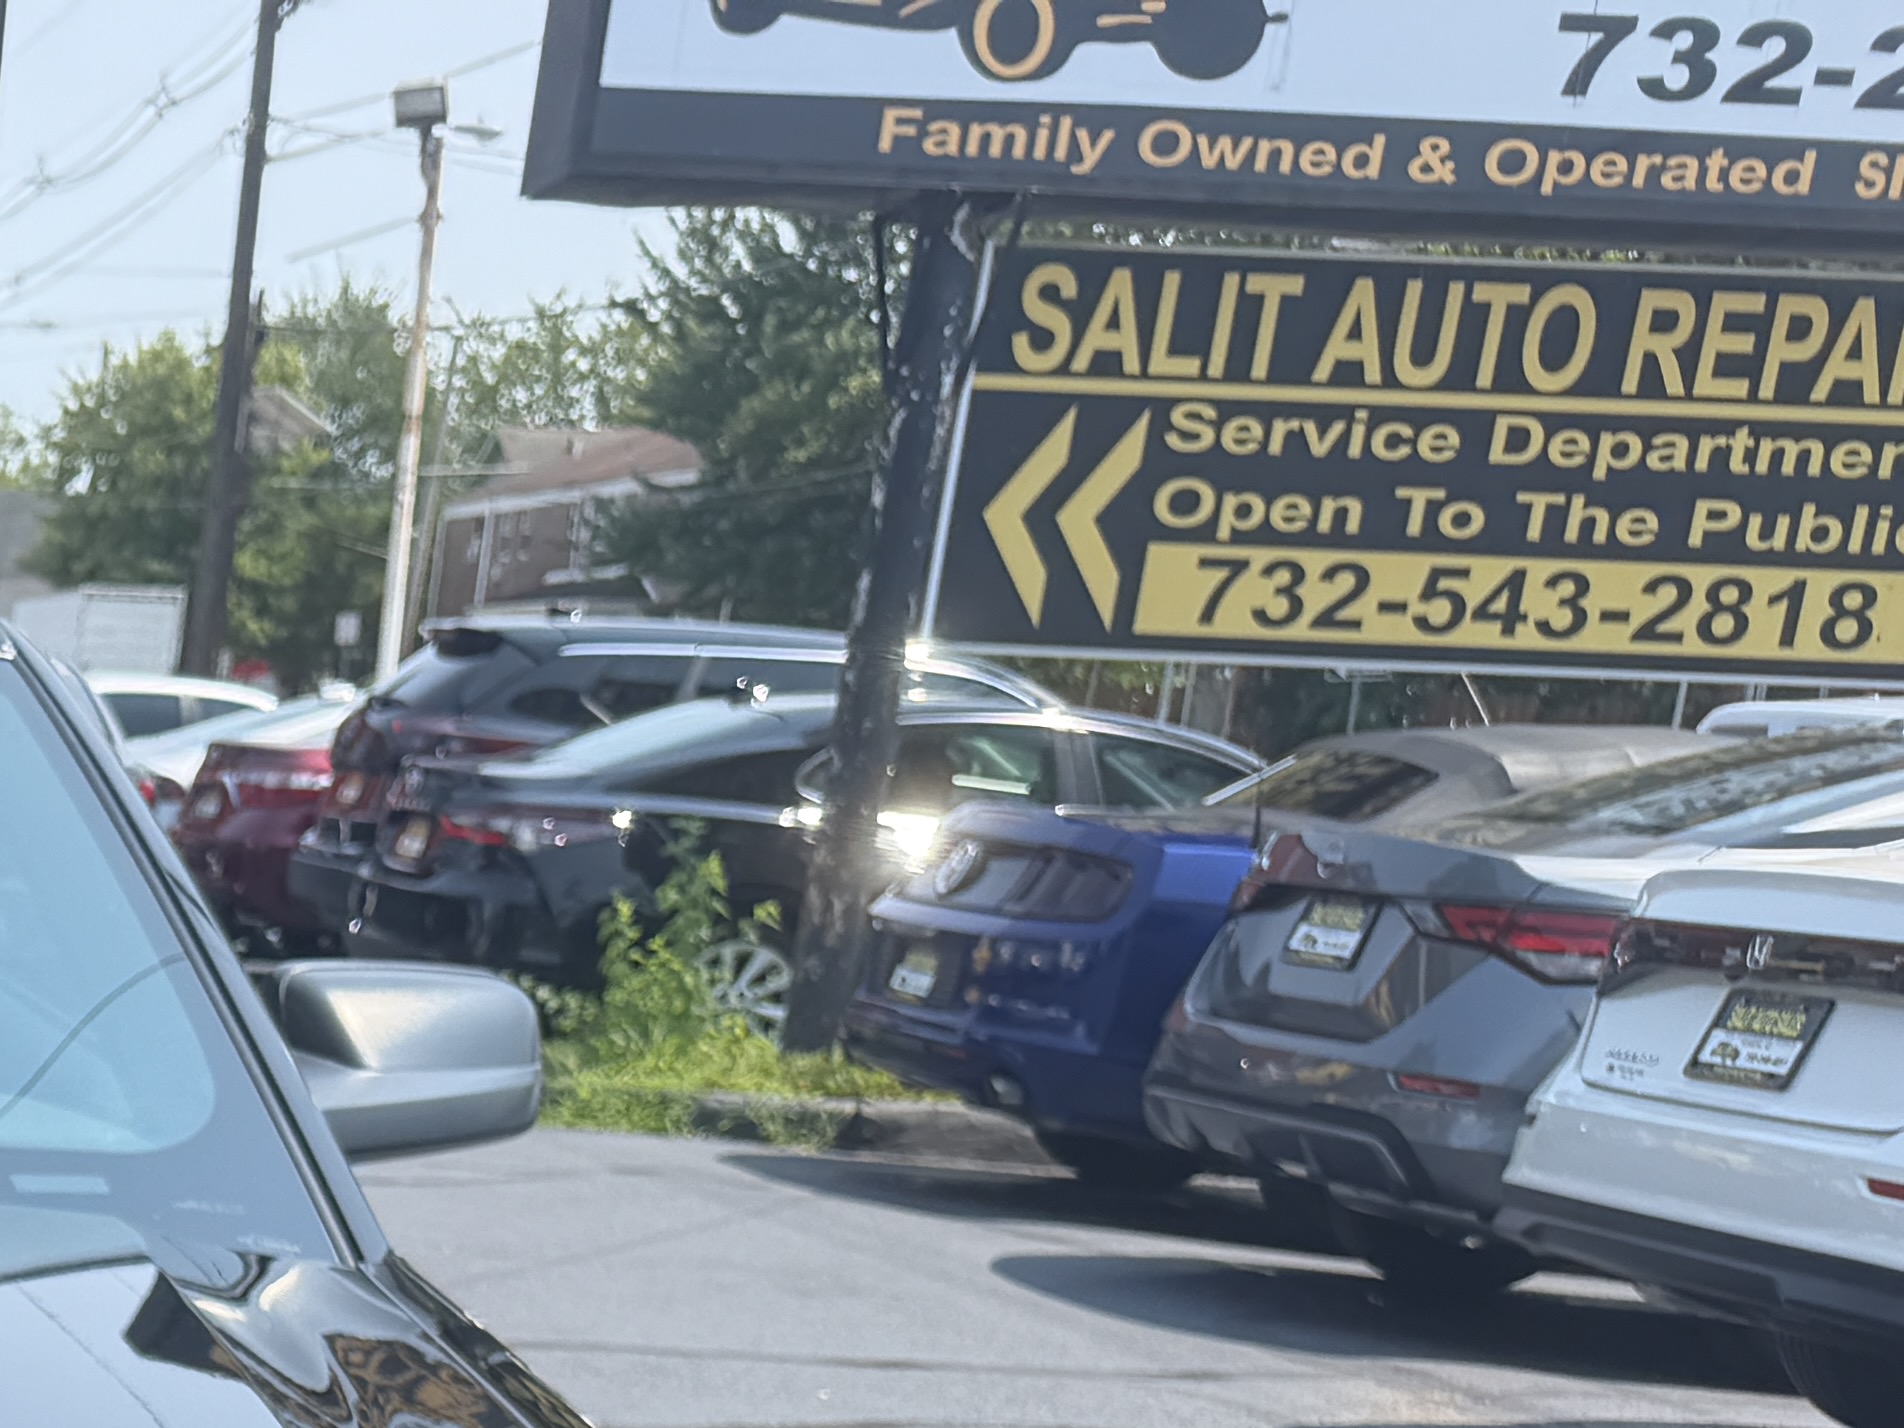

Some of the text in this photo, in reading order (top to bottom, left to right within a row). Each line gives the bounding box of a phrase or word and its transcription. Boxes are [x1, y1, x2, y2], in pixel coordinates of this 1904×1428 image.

[878, 106, 1115, 175] Family
[1138, 119, 1386, 180] Owned
[1407, 136, 1456, 185] &
[1484, 138, 1816, 195] Operated
[1011, 262, 1305, 381] SALIT
[1310, 277, 1596, 394] AUTO
[1164, 401, 1460, 463] Service
[1152, 477, 1904, 555] Open To The Publi
[1196, 557, 1878, 651] 732-543-2818
